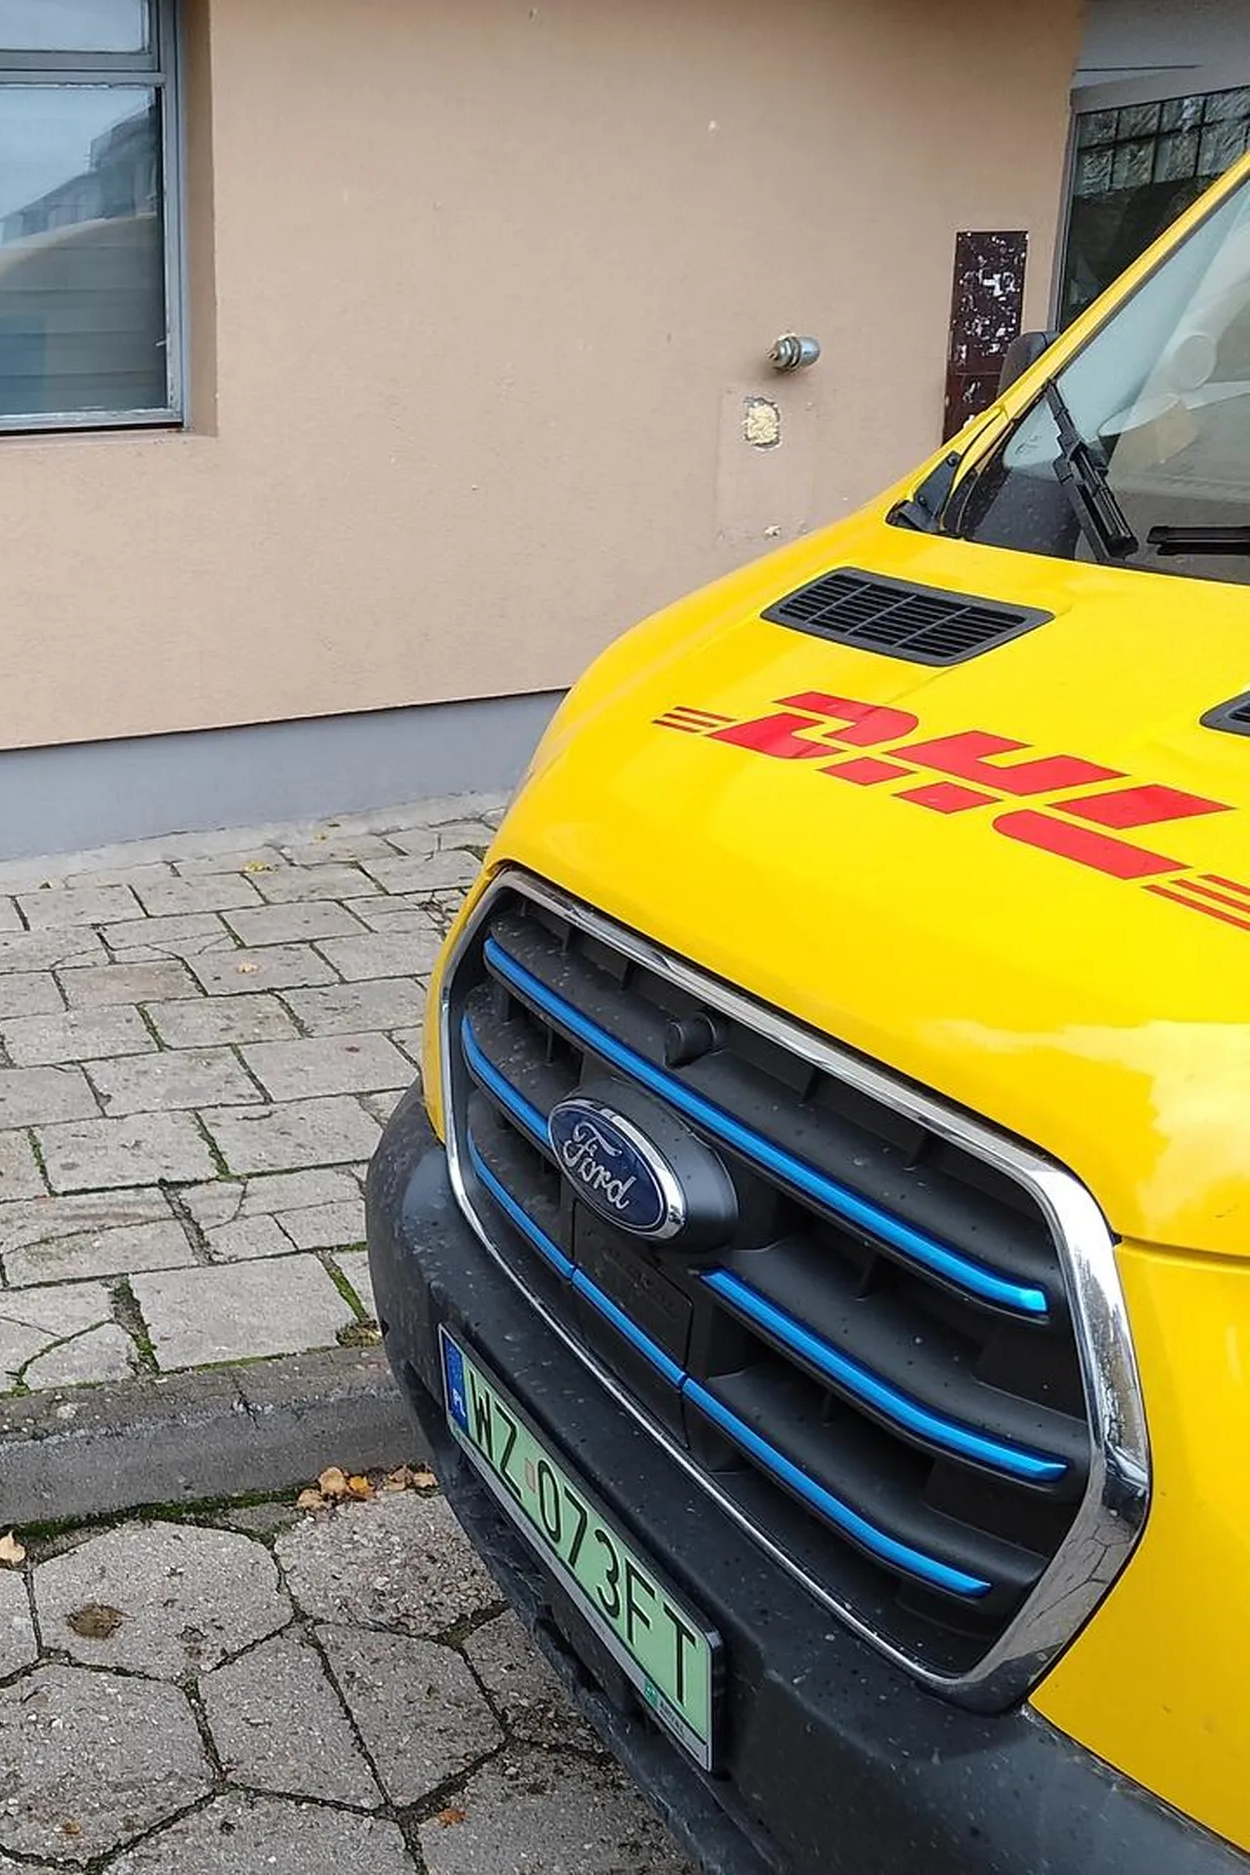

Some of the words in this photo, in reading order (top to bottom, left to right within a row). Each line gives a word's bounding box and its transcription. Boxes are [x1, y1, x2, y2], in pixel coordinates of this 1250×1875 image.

[705, 691, 1237, 880] DHL
[563, 1122, 637, 1210] Ford
[468, 1367, 522, 1499] WZ
[537, 1459, 697, 1705] 073FT
